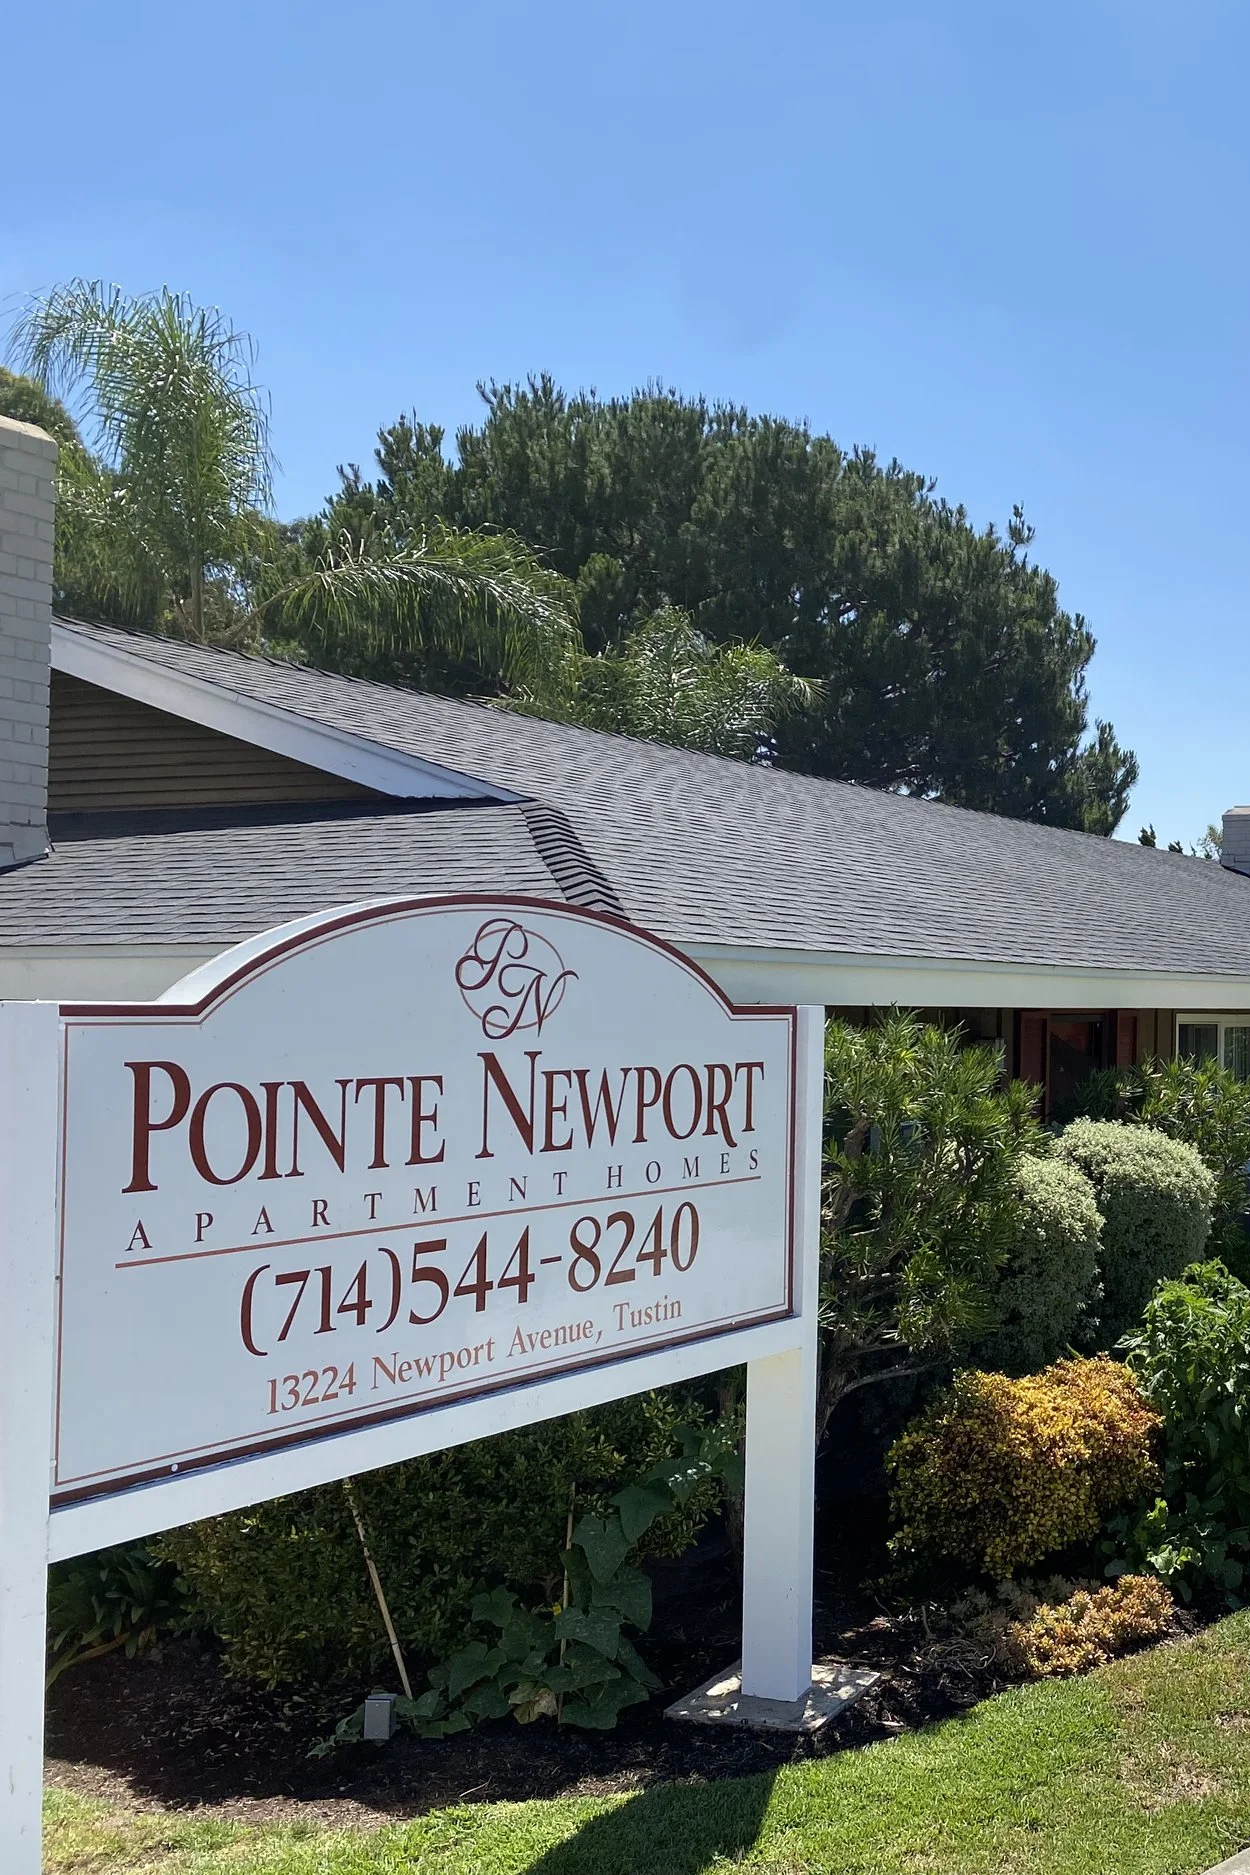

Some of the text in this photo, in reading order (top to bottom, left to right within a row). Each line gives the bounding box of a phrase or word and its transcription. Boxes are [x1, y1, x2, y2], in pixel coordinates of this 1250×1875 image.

[121, 1050, 766, 1195] POINTE NEWPORT
[125, 1147, 761, 1253] APARTMENT HOMES
[239, 1200, 701, 1357] (714)544-8240
[266, 1294, 684, 1416] 13224 Newport Avenue, Tustin
